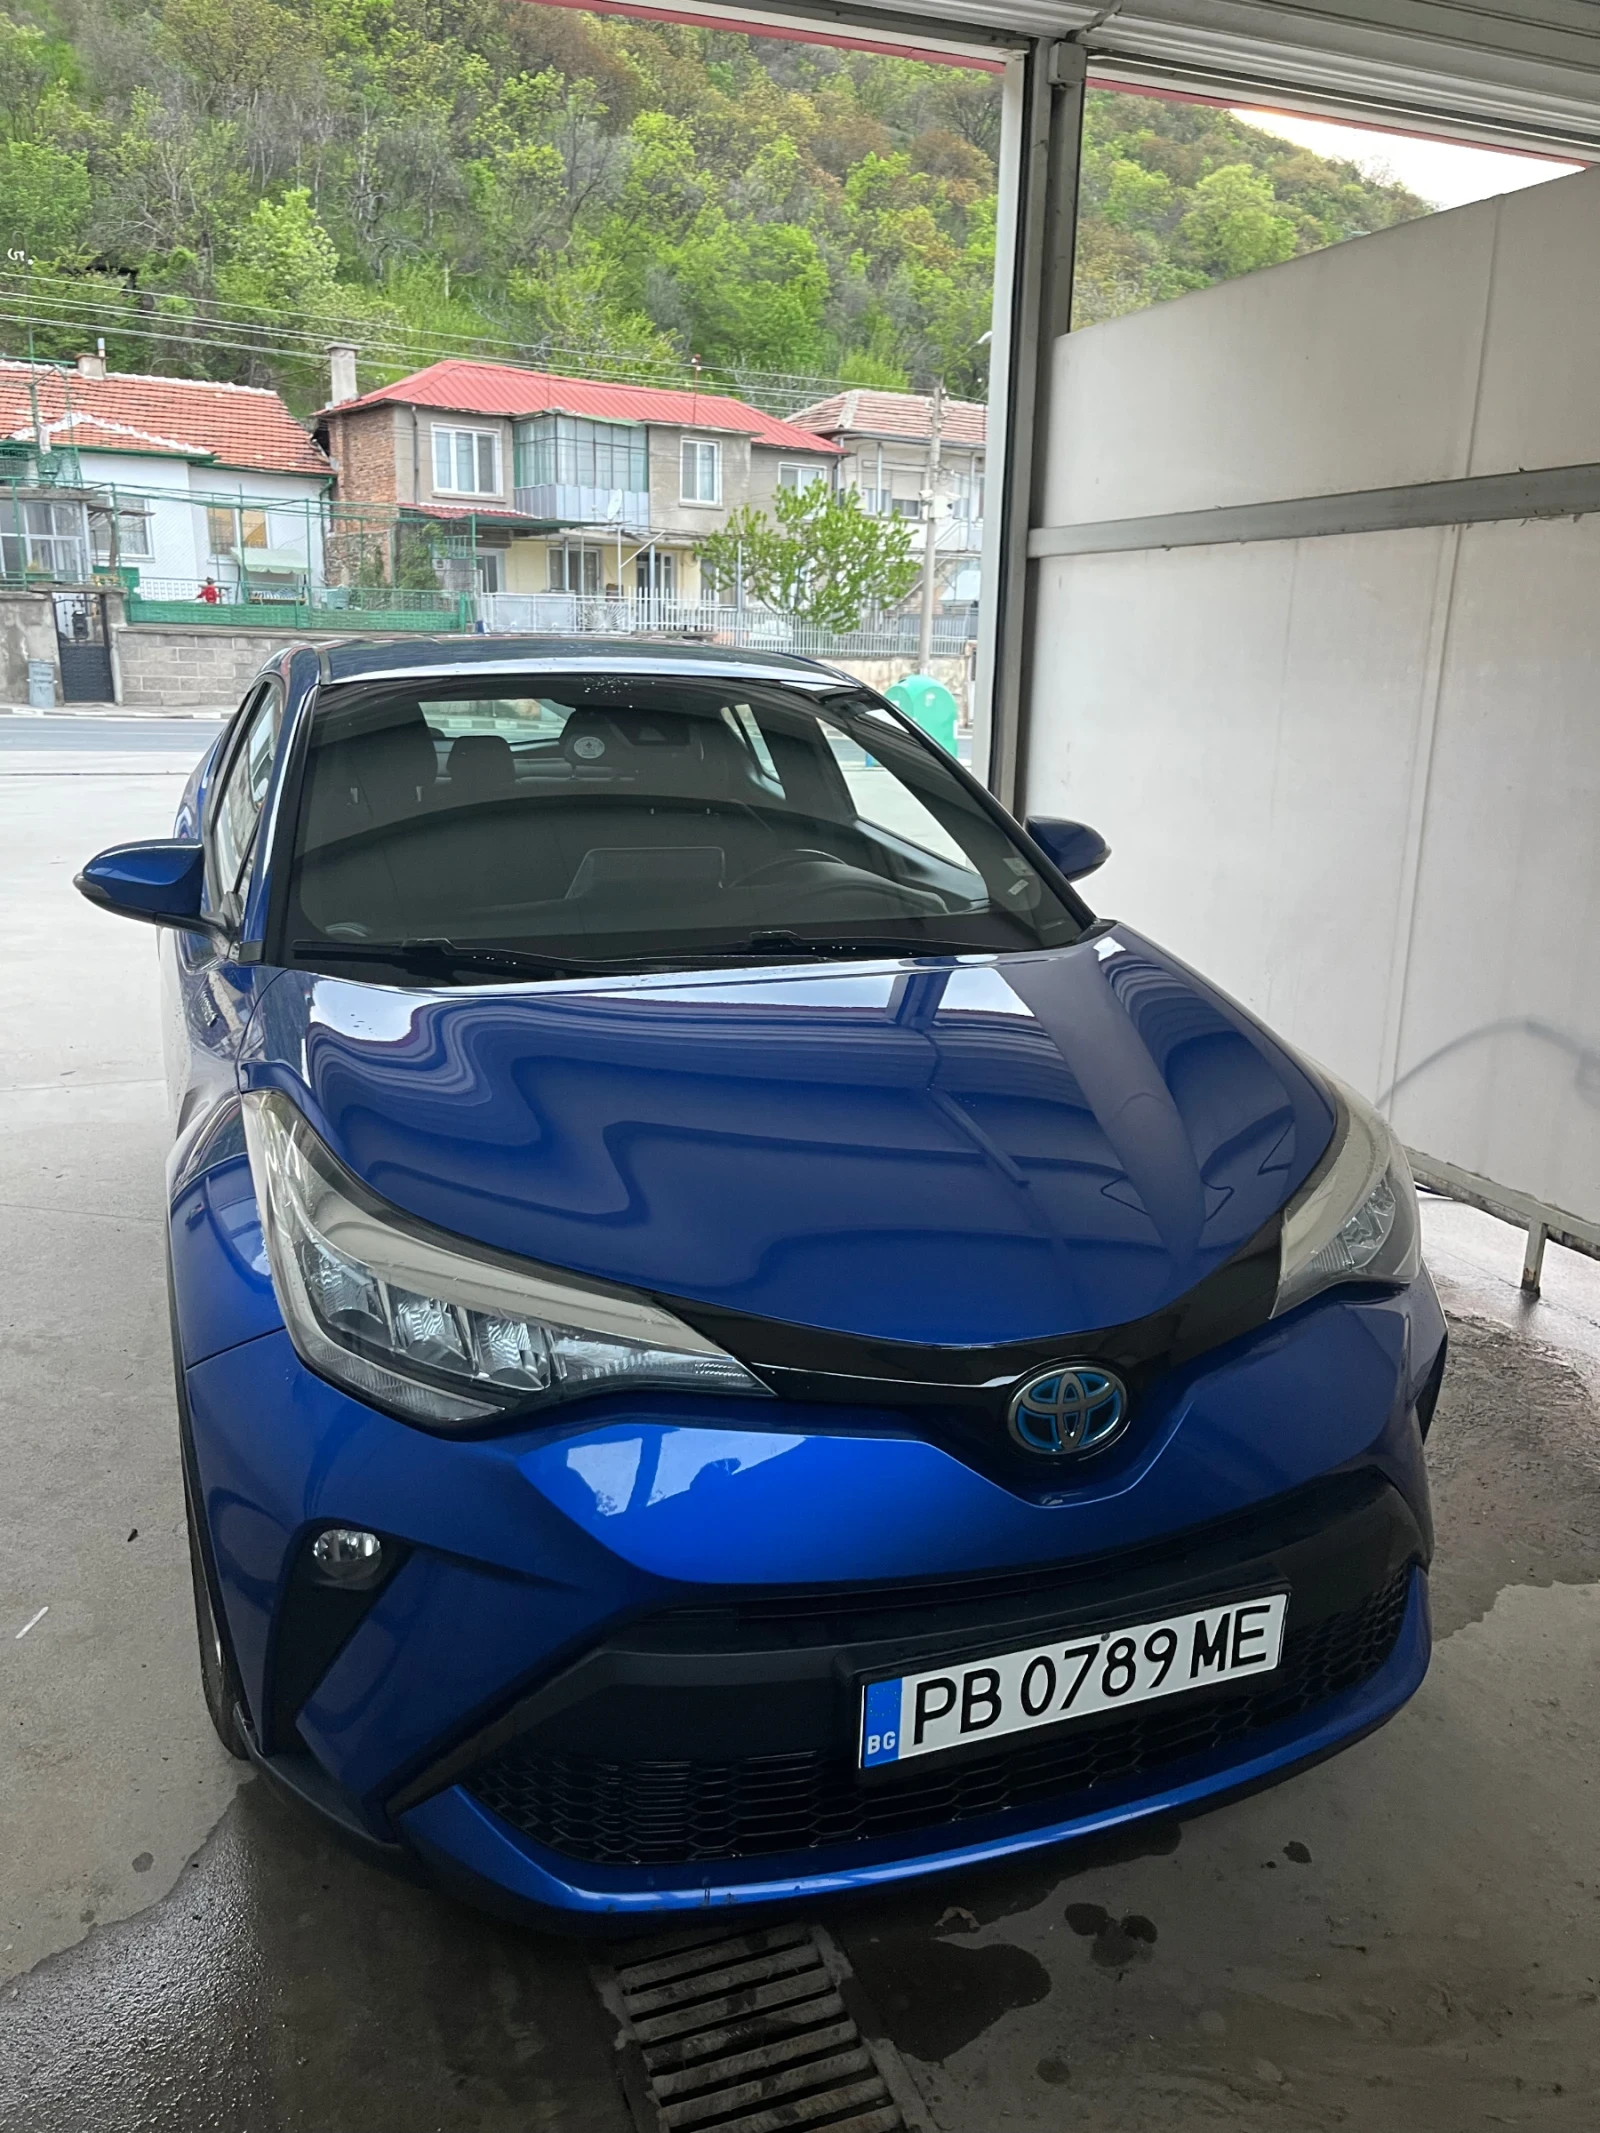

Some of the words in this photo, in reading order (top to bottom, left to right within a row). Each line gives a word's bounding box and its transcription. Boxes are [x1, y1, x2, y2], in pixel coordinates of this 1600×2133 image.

[913, 1668, 1002, 1745] PB
[1020, 1628, 1178, 1717] 0789
[1189, 1604, 1271, 1679] ME
[867, 1731, 896, 1755] BG
